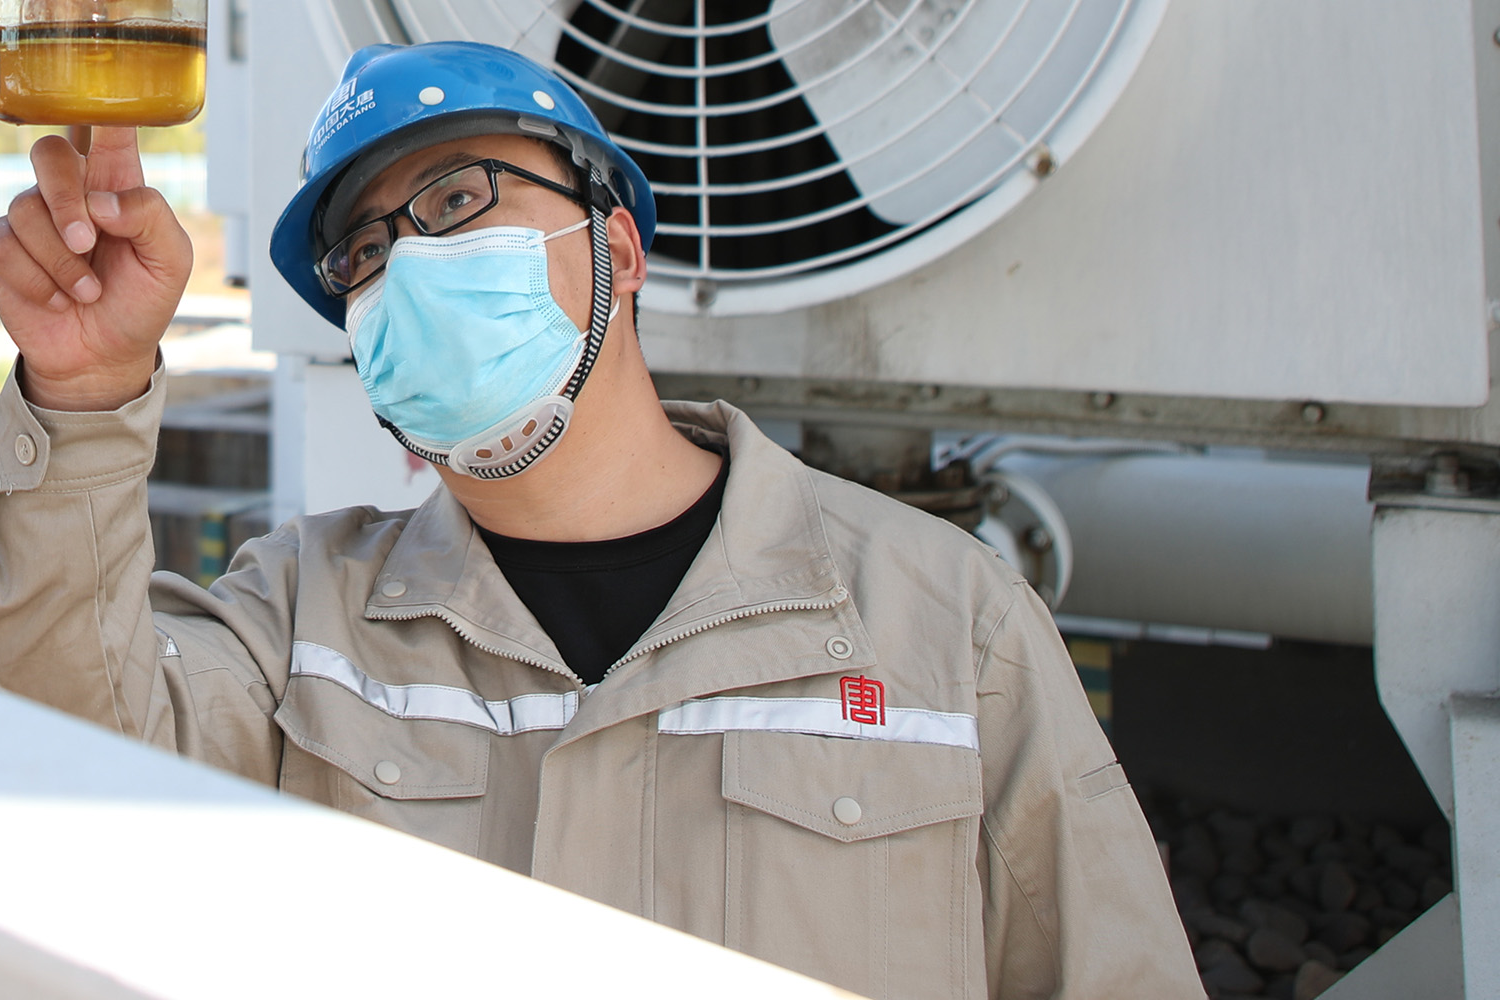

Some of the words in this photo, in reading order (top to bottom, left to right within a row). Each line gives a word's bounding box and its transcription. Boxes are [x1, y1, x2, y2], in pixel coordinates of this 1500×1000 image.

[314, 88, 374, 145] 中国大唐
[315, 128, 336, 155] CHINA
[336, 101, 377, 131] DATANG
